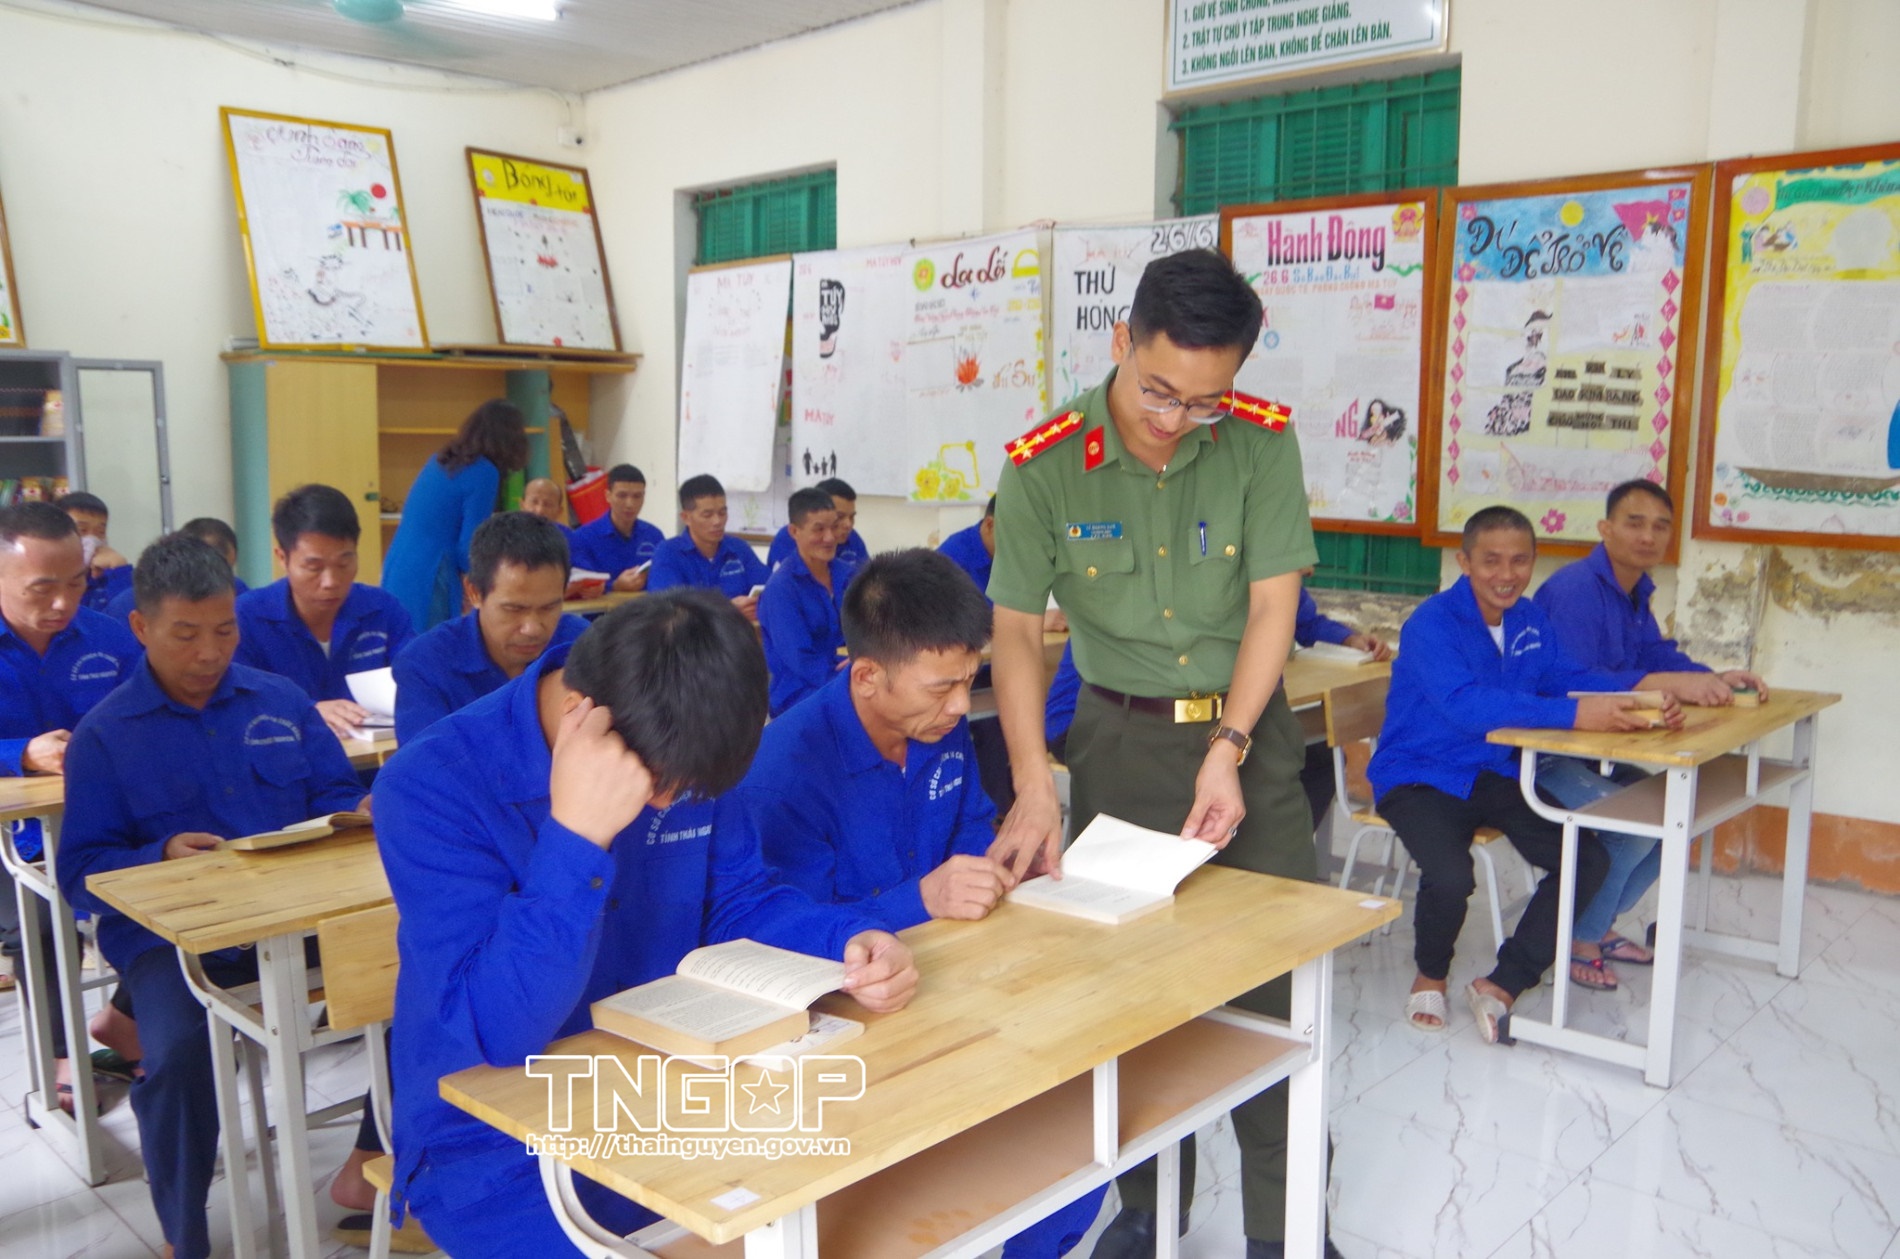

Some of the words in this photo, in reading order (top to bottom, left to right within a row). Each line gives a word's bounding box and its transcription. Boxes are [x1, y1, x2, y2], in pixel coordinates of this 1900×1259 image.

[1220, 0, 1239, 16] SINH
[1267, 12, 1295, 33] TRUNG
[1296, 6, 1320, 27] NGHE
[1191, 52, 1217, 73] KHÔNG
[1240, 43, 1256, 64] LÊN
[1280, 35, 1309, 57] KHÔNG
[1325, 26, 1349, 49] CHÂN
[1351, 23, 1368, 45] LÊN
[1327, 214, 1386, 272] Động
